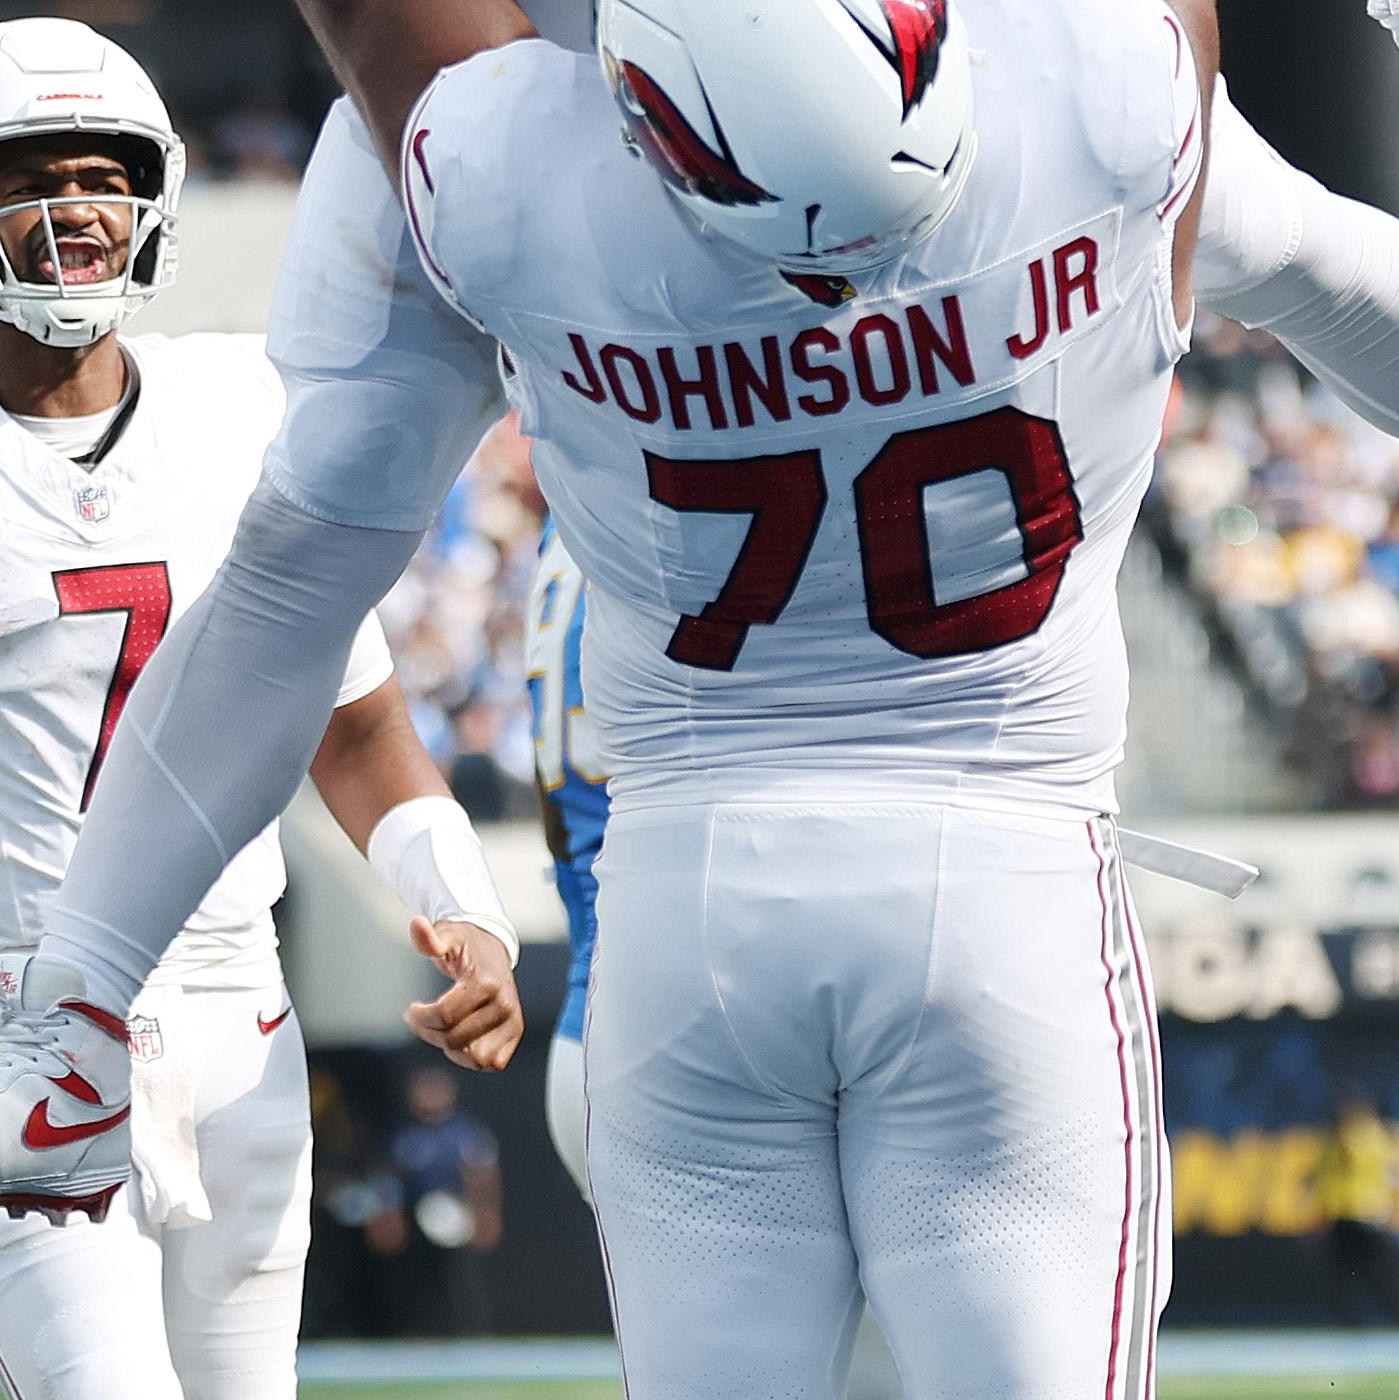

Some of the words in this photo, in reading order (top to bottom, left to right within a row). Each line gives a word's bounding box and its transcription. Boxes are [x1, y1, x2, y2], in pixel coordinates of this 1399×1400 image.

[561, 295, 976, 431] JOHNSON
[1005, 236, 1102, 362] JR
[642, 404, 1084, 673] 70
[51, 561, 174, 814] 7
